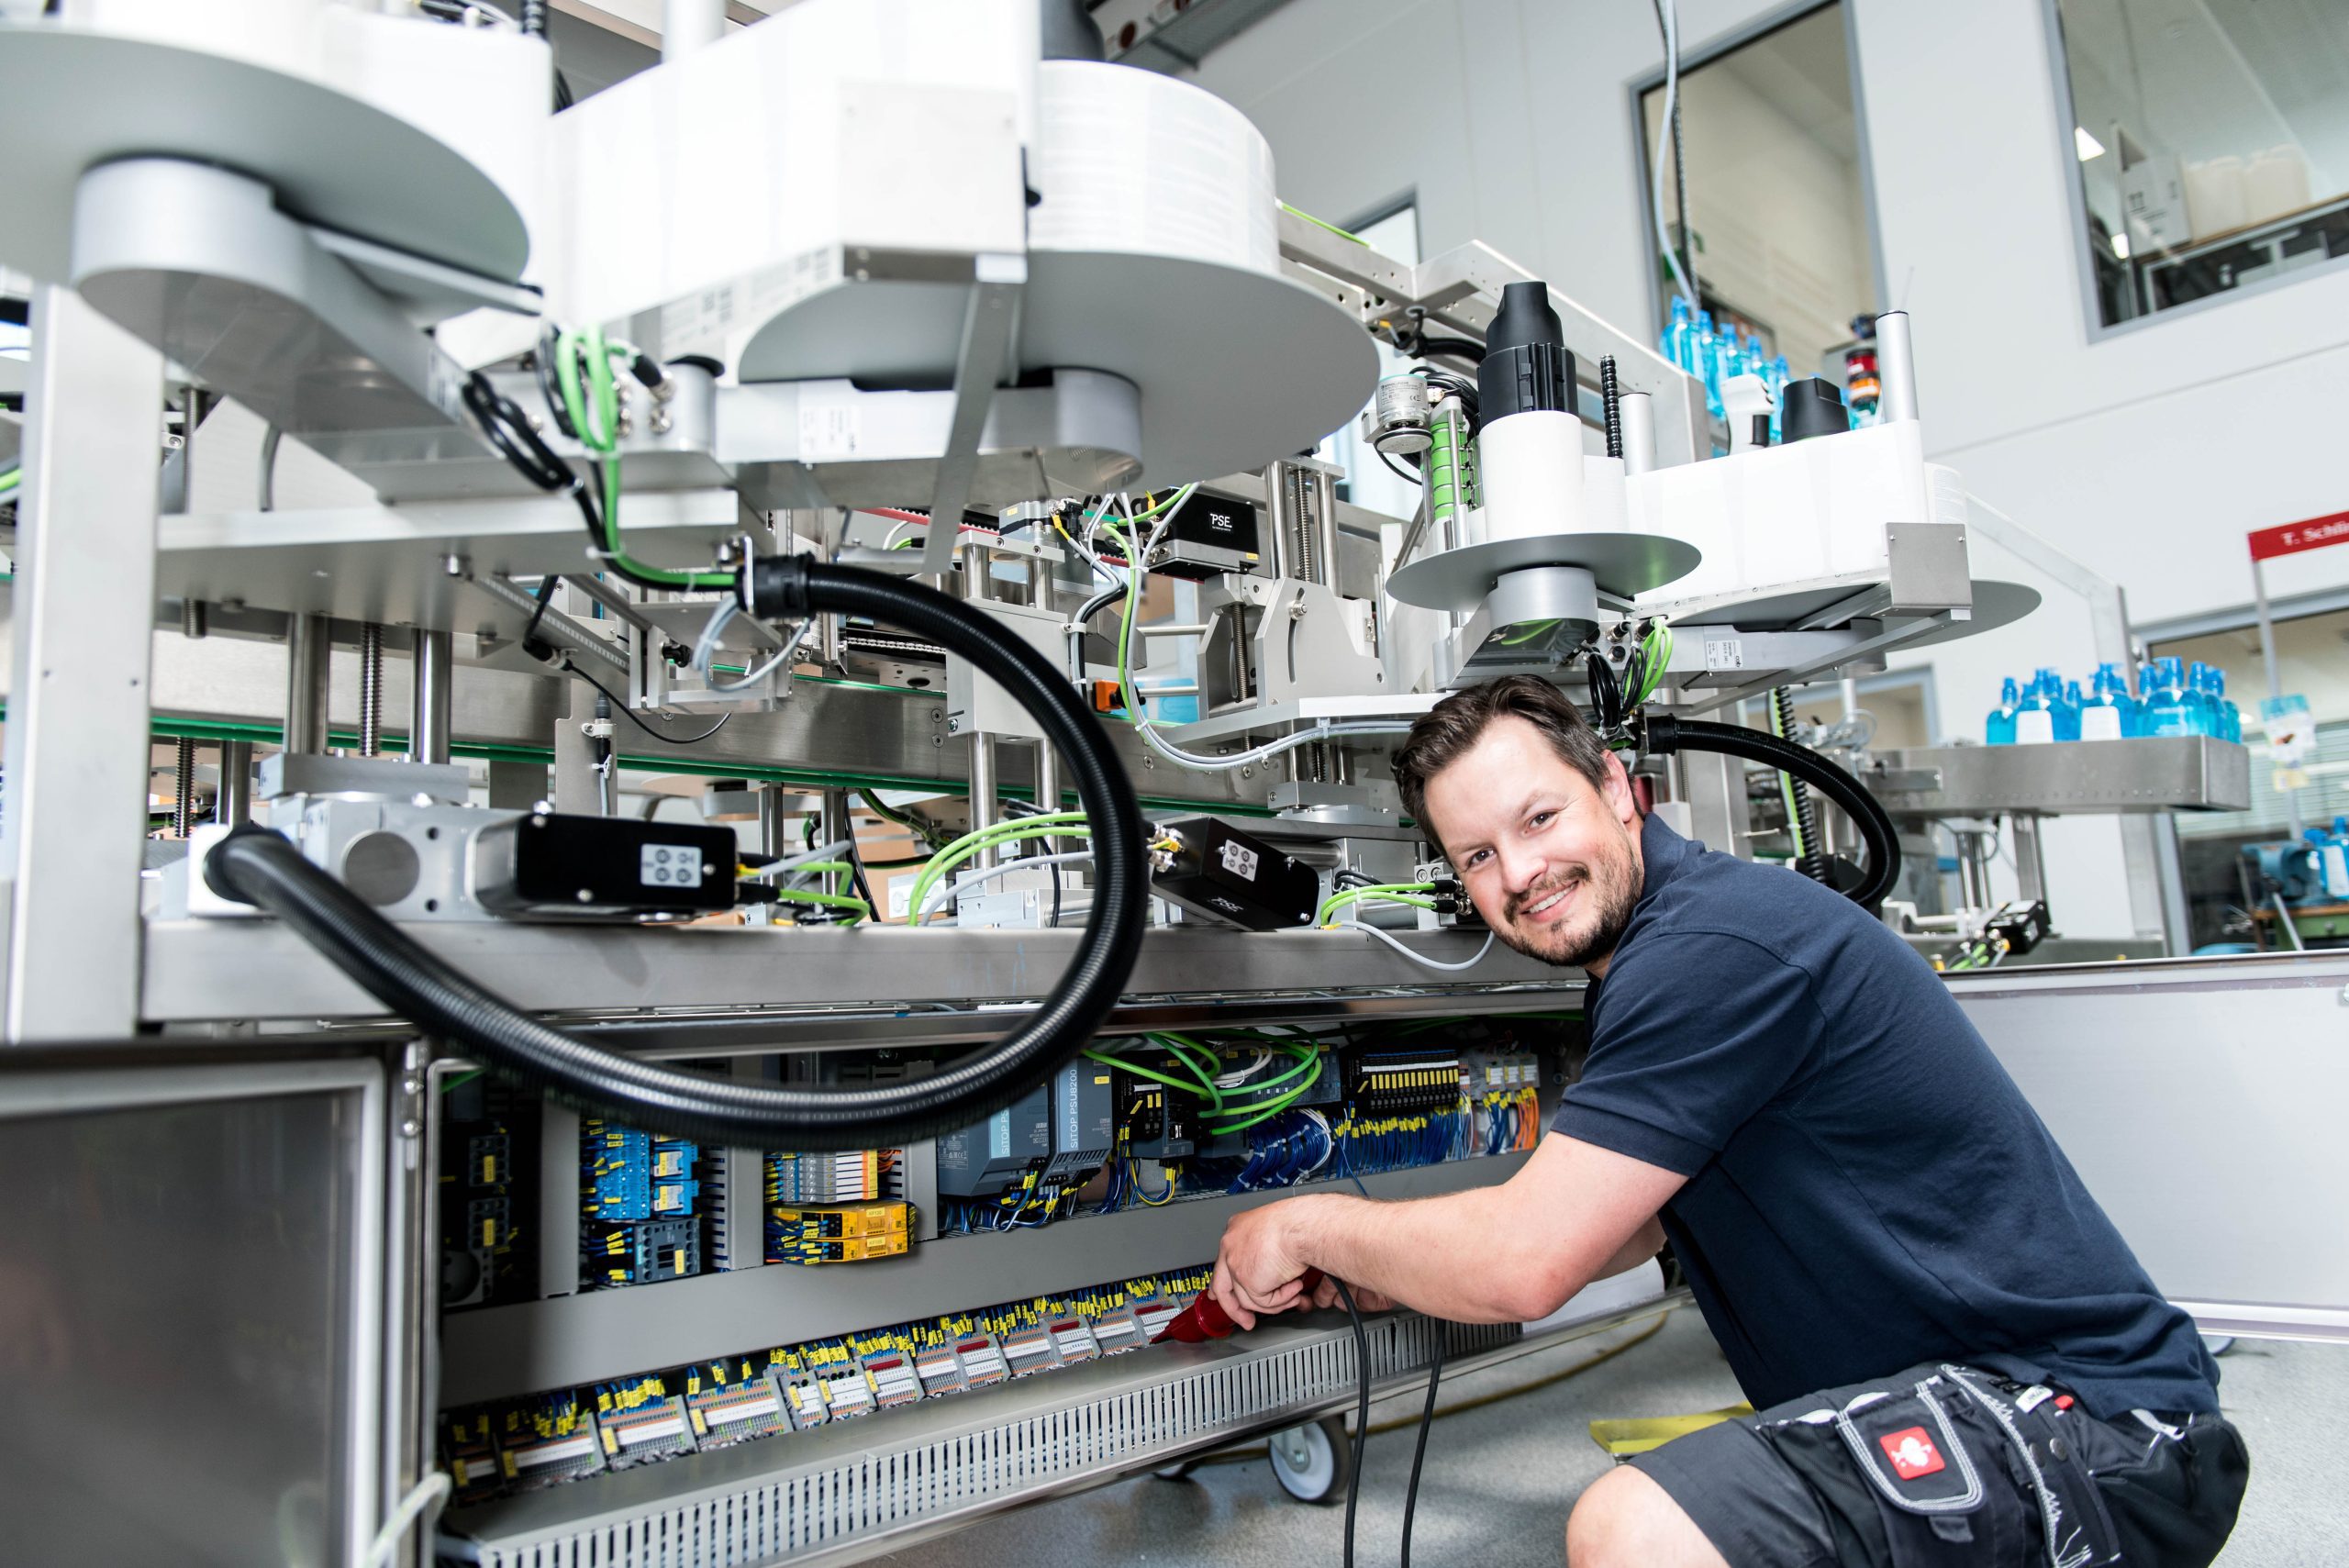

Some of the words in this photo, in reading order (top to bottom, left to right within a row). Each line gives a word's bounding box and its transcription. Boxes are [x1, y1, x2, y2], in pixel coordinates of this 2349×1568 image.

[1210, 513, 1232, 528] PSE
[1069, 1069, 1078, 1115] PSU8200
[1000, 1125, 1009, 1155] SITOP
[1070, 1117, 1078, 1149] SITOP
